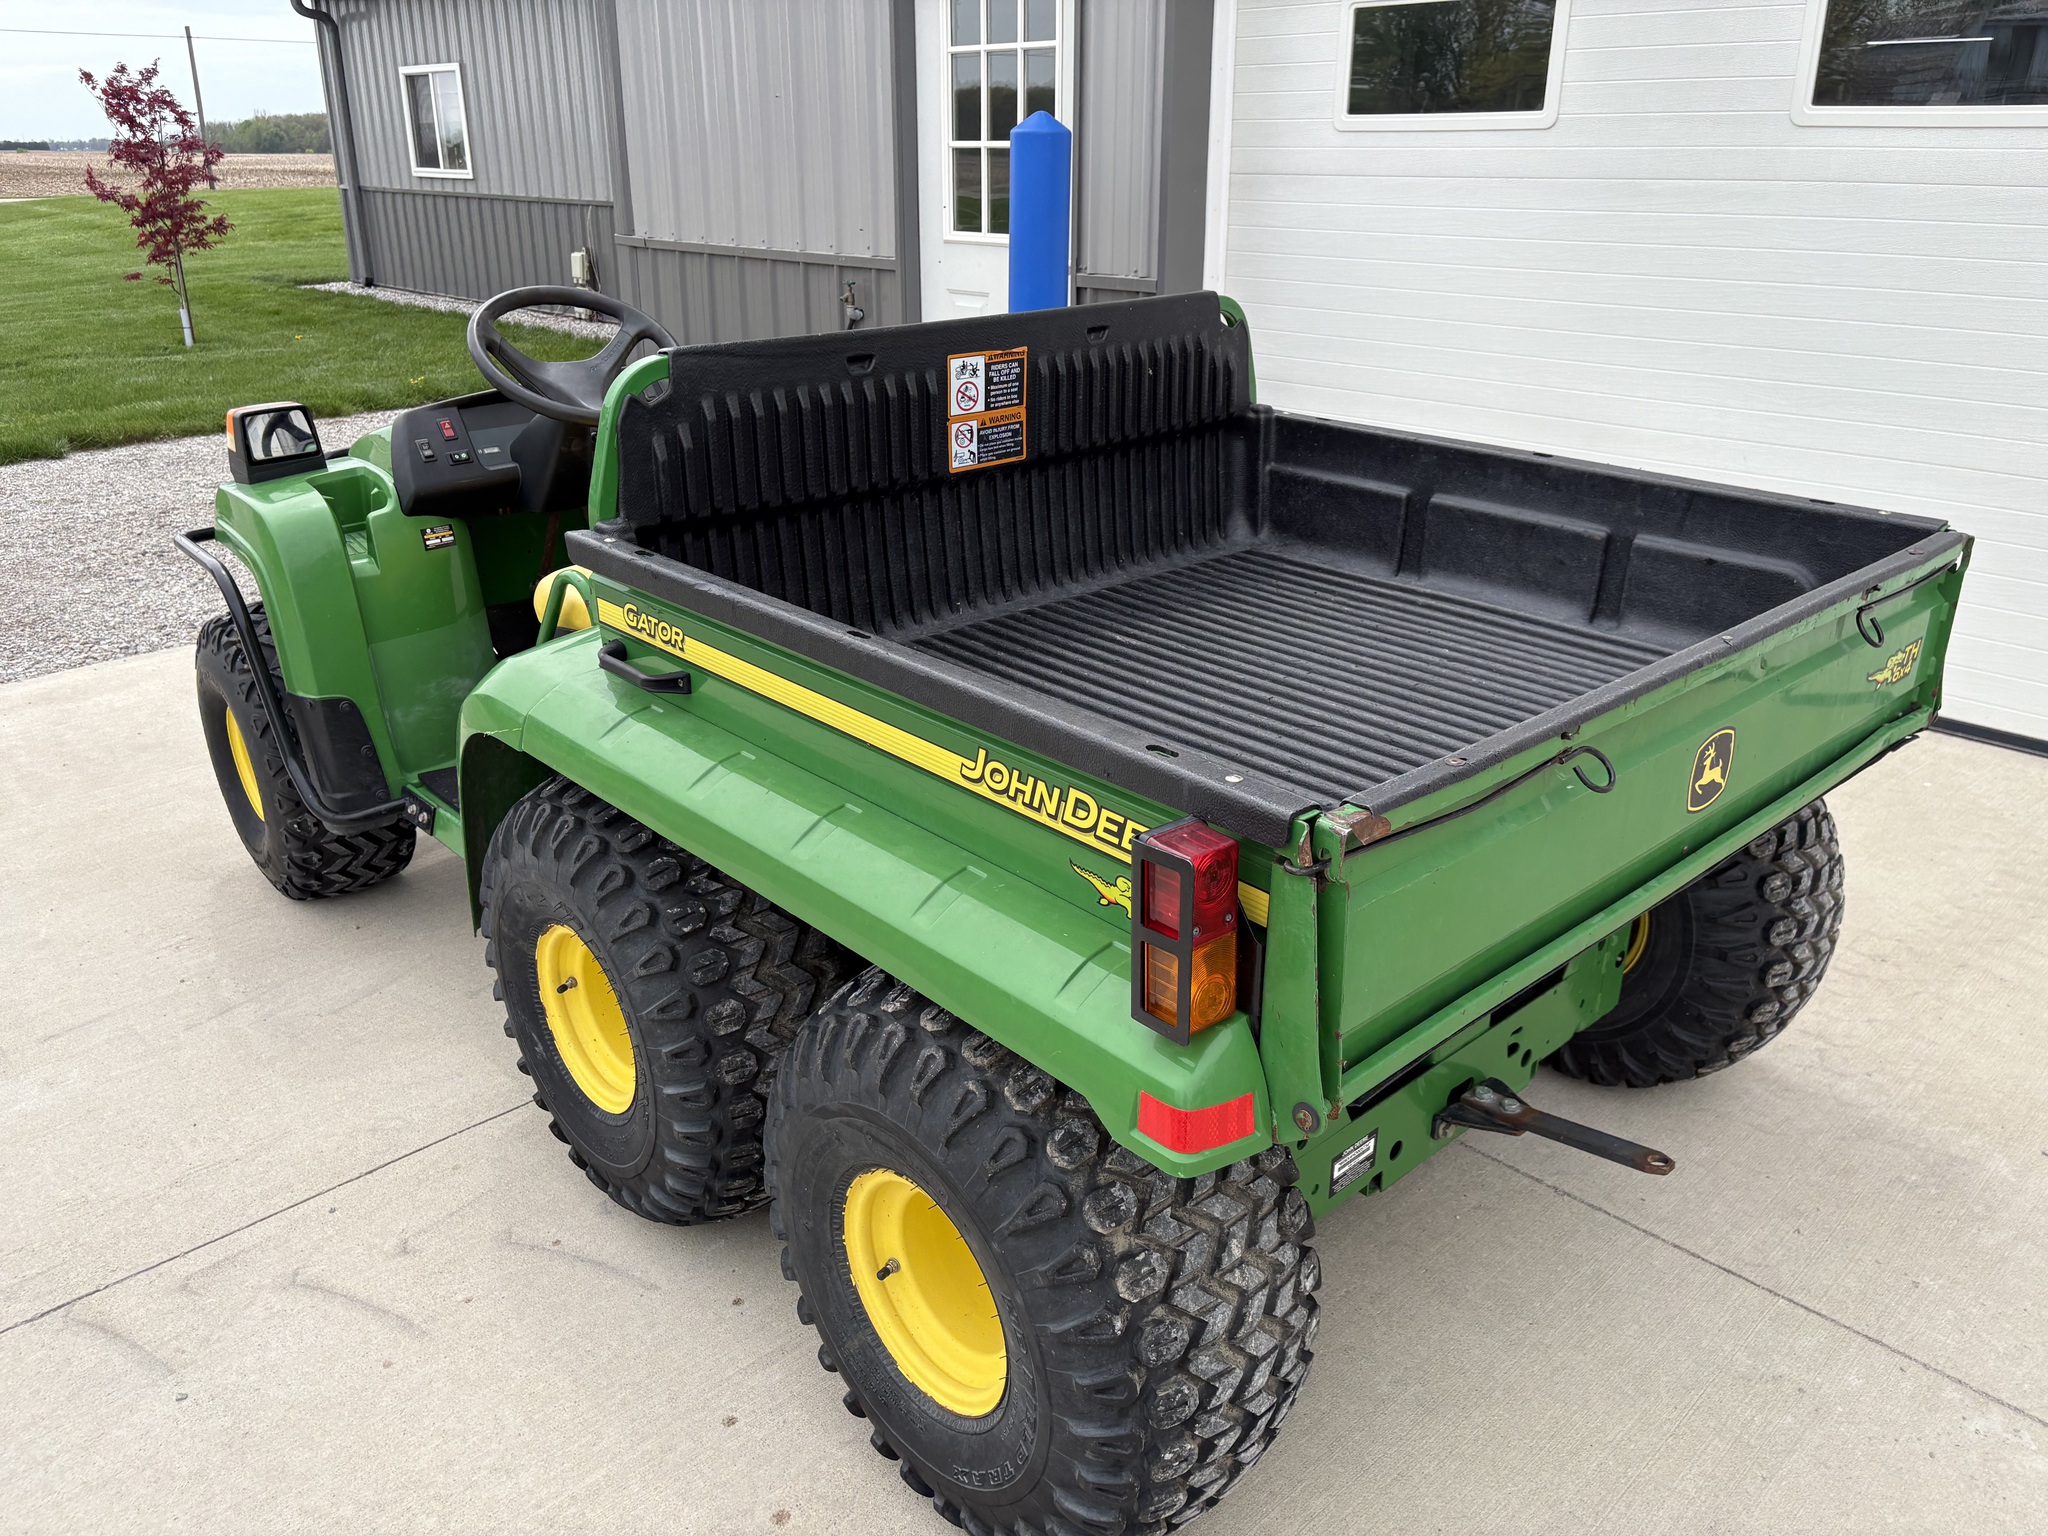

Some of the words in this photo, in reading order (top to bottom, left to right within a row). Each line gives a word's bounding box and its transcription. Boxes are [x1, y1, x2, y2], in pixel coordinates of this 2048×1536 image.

[993, 352, 1024, 360] WARNING
[989, 412, 1021, 424] WARNING
[989, 432, 1012, 440] EXPLOSION
[623, 602, 684, 652] GATOR
[1904, 639, 1921, 664] TH
[960, 747, 1063, 823] JOHN
[953, 1460, 1015, 1486] TRAX
